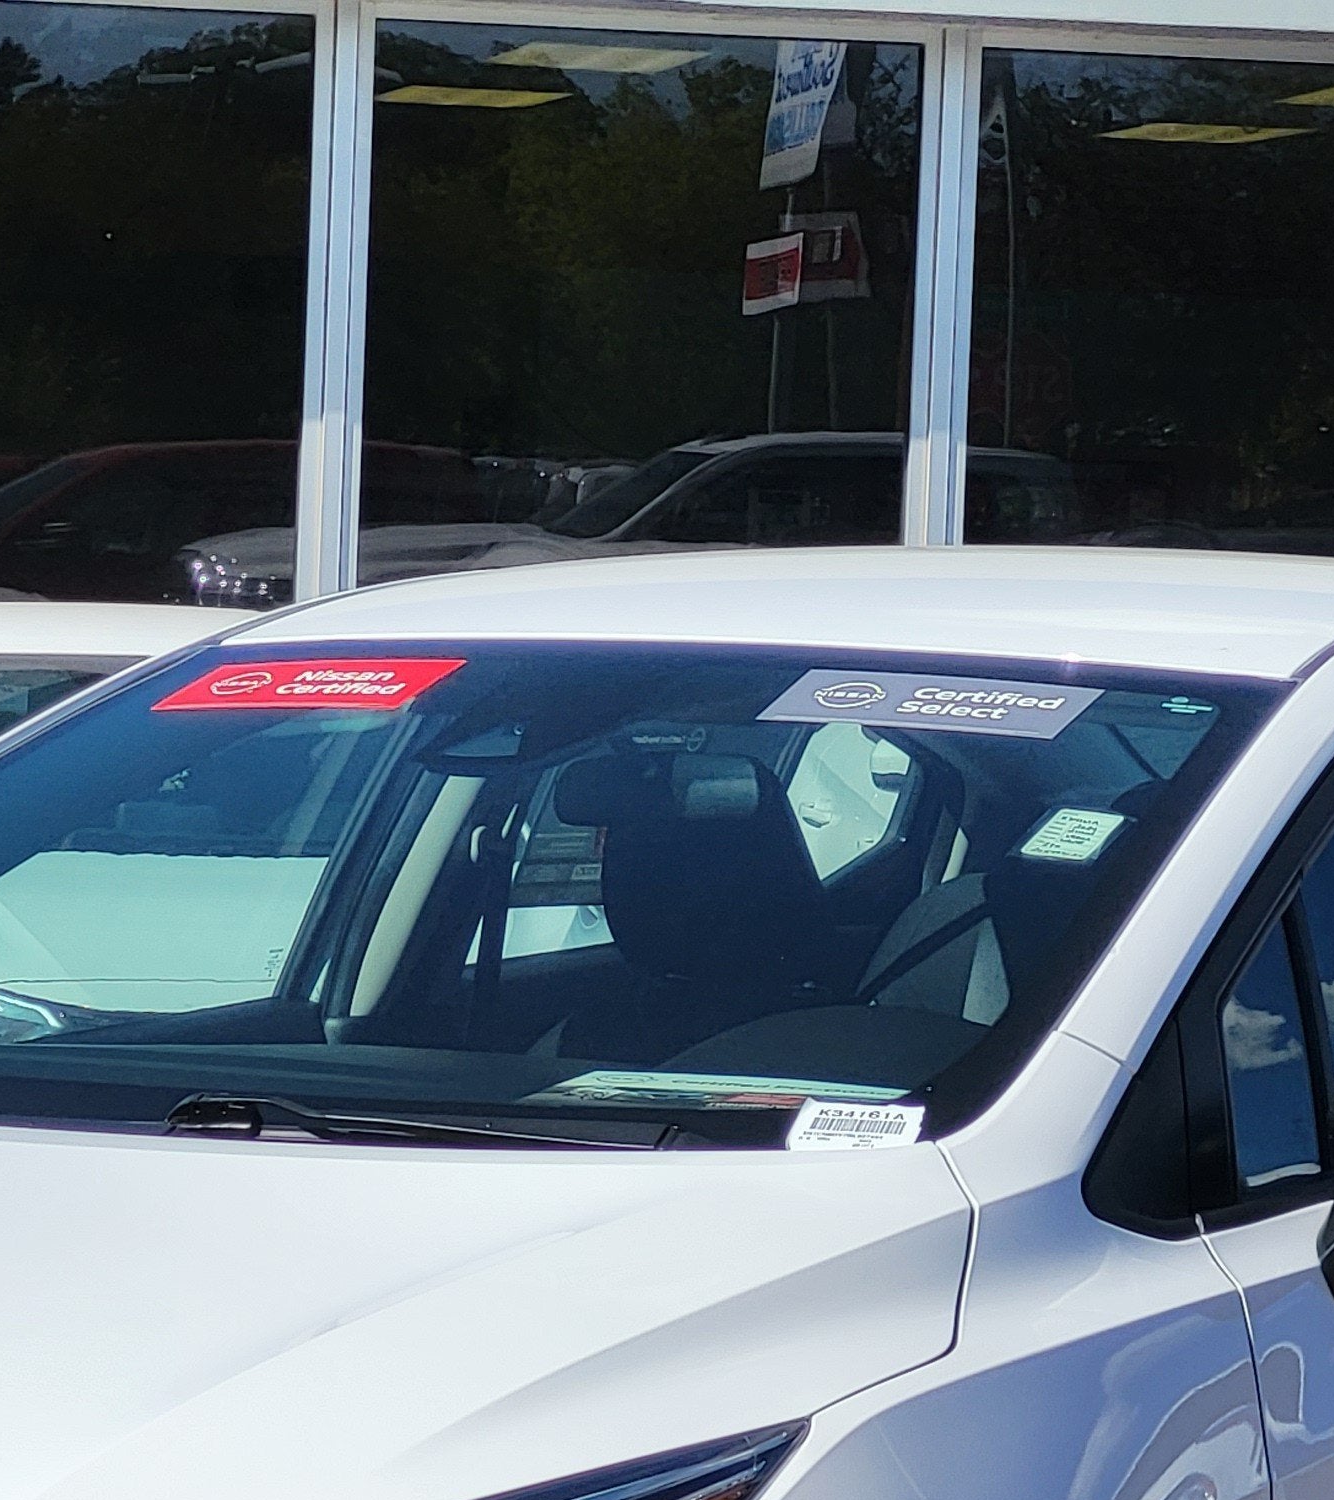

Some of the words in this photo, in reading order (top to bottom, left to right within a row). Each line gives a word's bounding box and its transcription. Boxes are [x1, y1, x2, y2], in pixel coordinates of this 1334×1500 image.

[294, 670, 395, 682] Nissan
[275, 682, 406, 695] Certified
[814, 690, 887, 700] NISSAN
[913, 687, 1066, 710] Certified
[896, 700, 1009, 720] Select
[819, 1109, 904, 1121] K34161A
